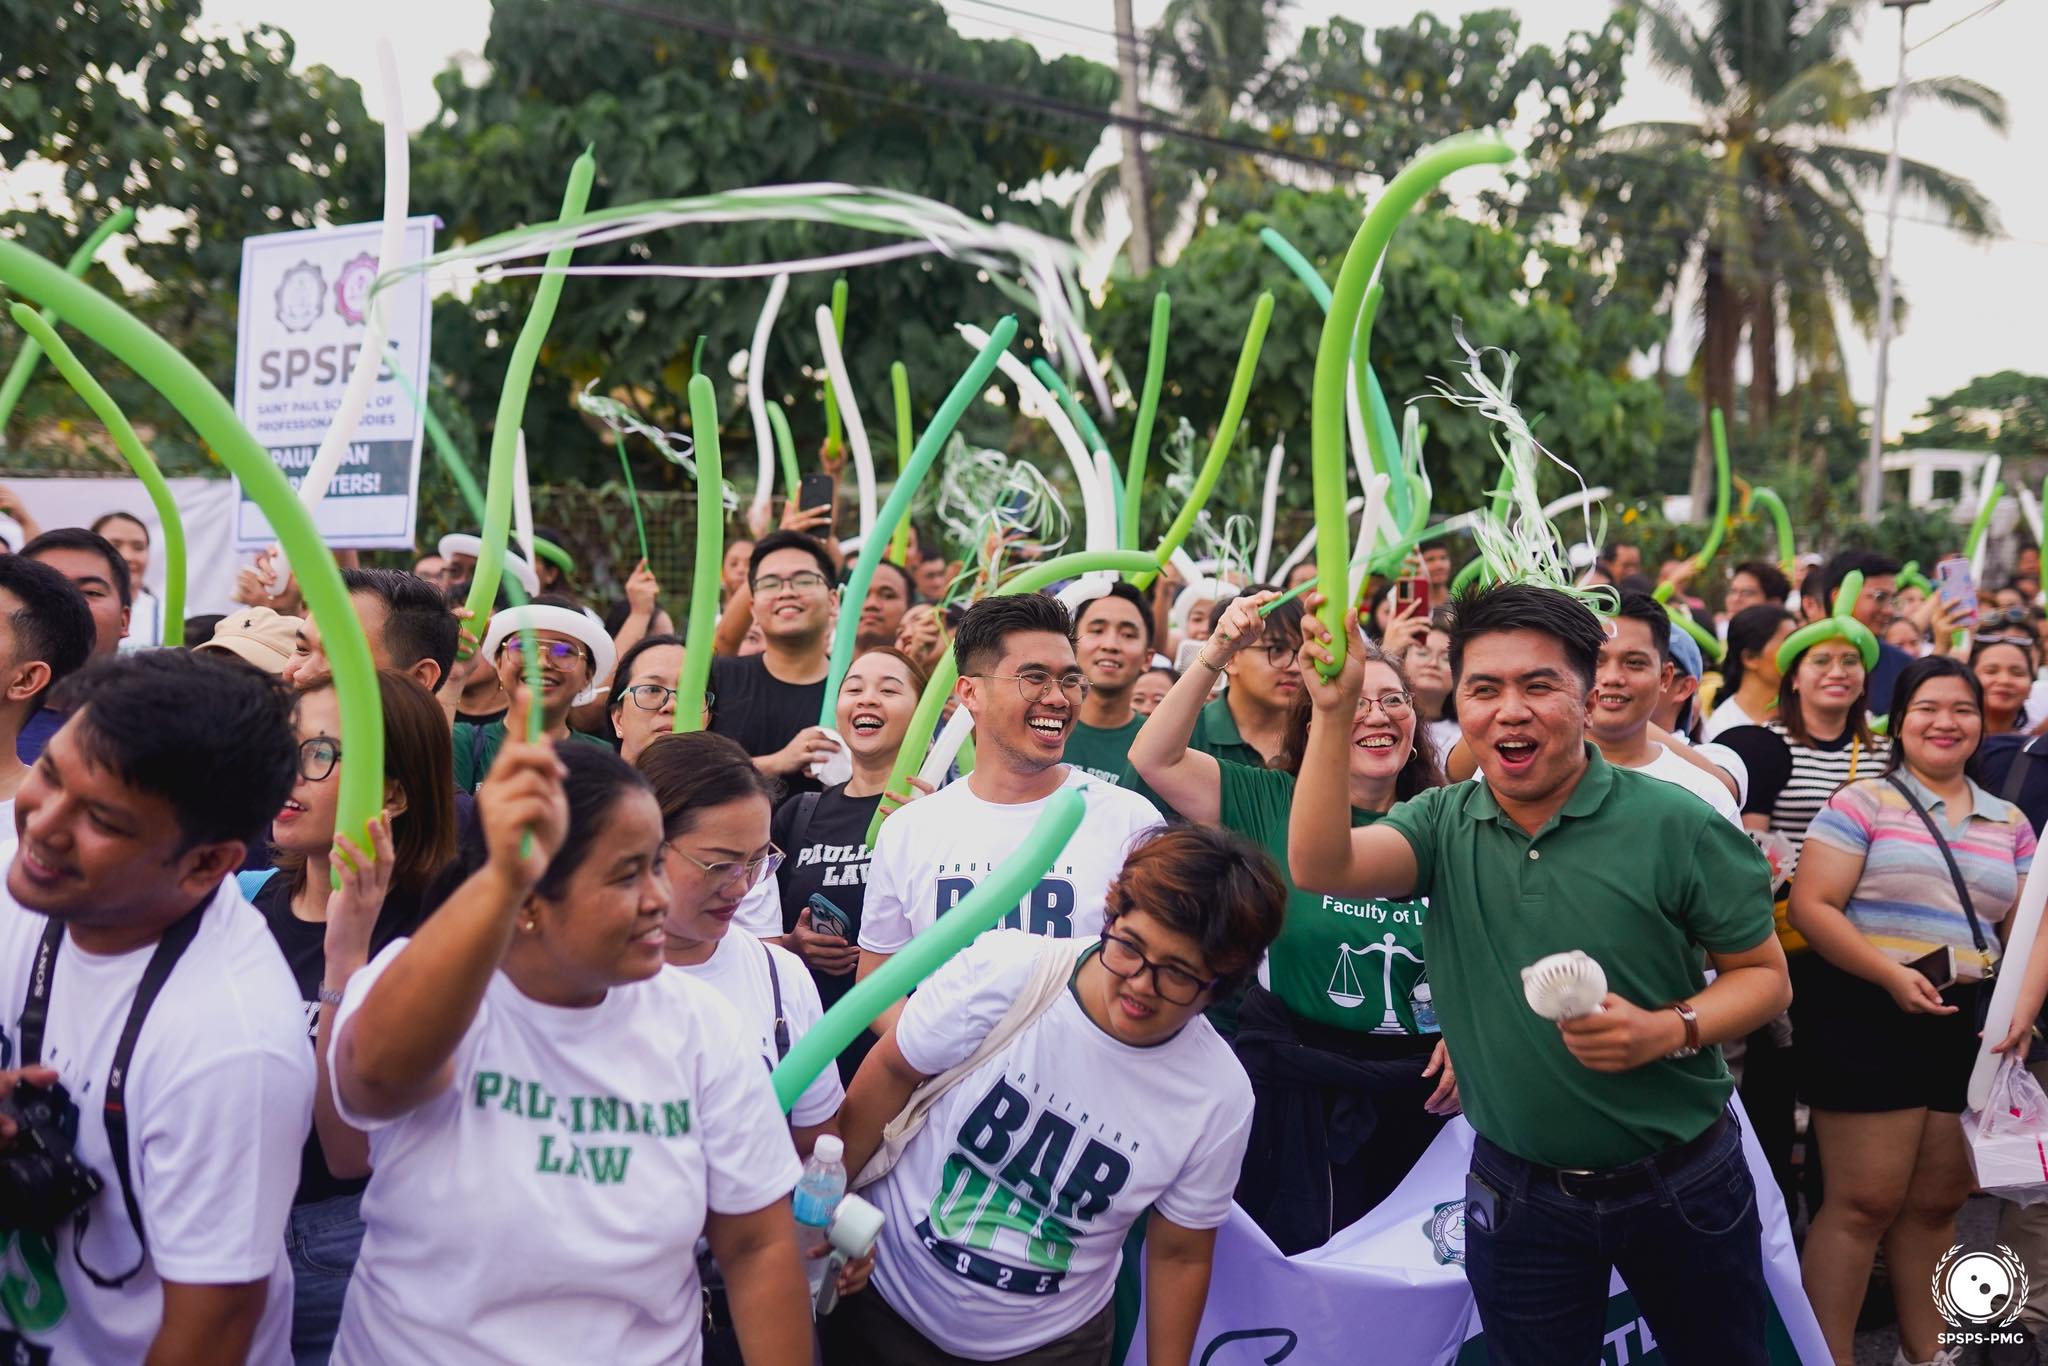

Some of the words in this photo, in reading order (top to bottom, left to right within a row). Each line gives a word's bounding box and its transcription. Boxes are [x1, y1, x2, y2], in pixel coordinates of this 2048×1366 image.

[256, 402, 289, 414] SAINT
[292, 400, 319, 412] PAUL
[376, 395, 394, 407] OF
[256, 416, 333, 432] PROFESSIONA
[1322, 894, 1387, 924] Faculty
[1392, 910, 1410, 924] of
[33, 943, 50, 997] SONY
[475, 1071, 691, 1138] PAUINIAN
[1015, 1070, 1141, 1153] AULINIAN
[536, 1135, 633, 1185] LAW
[955, 1072, 1134, 1224] BAR
